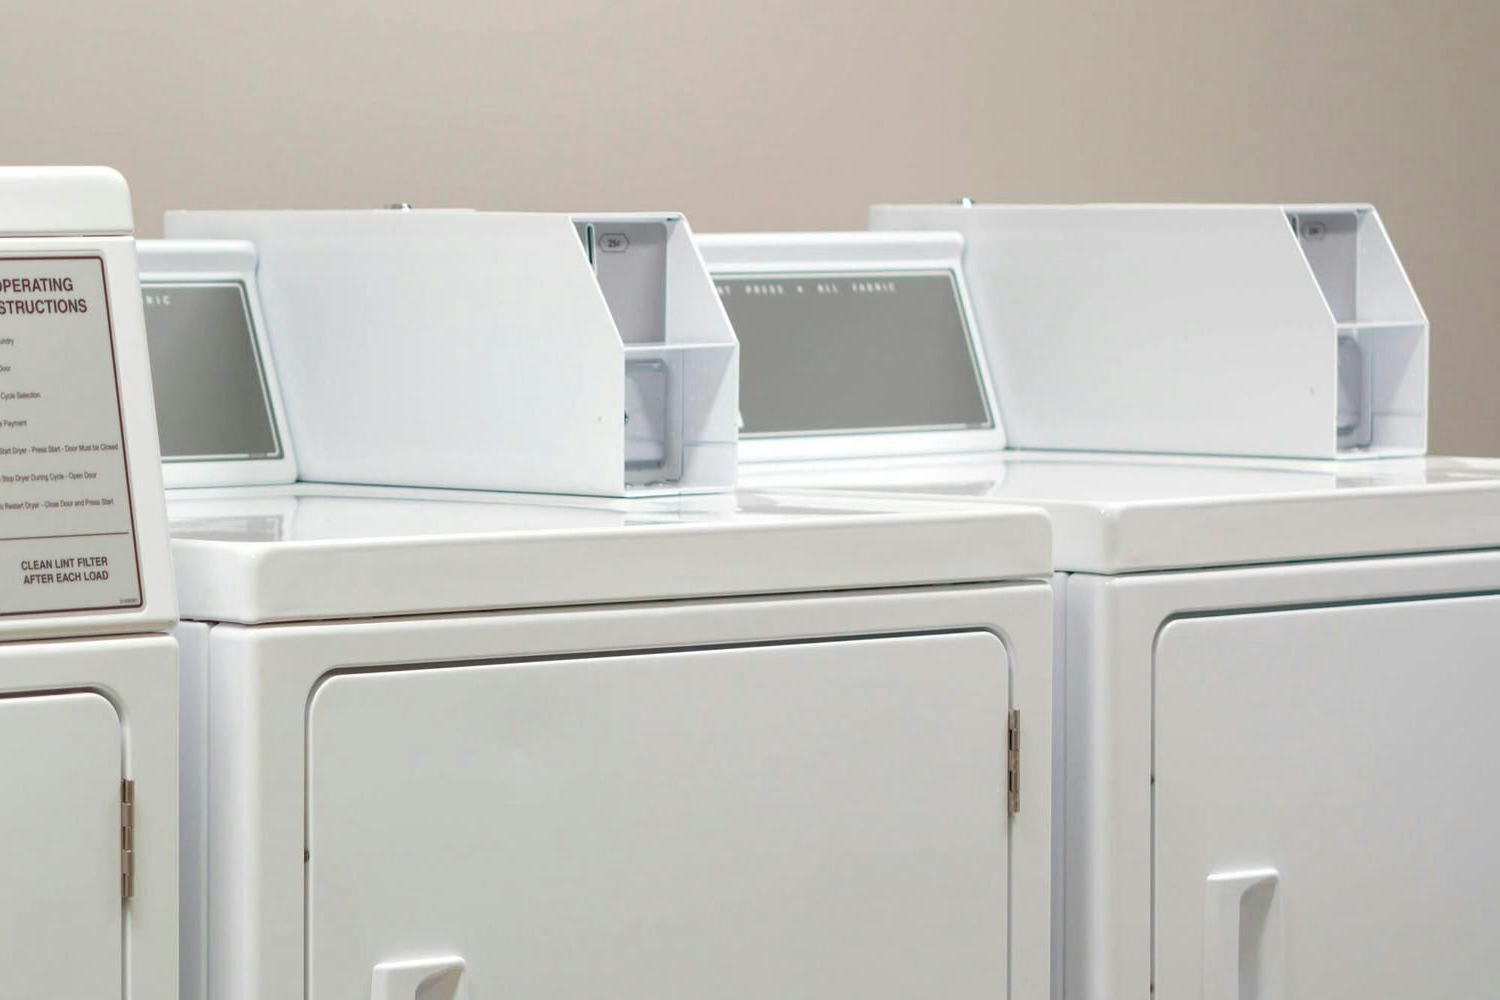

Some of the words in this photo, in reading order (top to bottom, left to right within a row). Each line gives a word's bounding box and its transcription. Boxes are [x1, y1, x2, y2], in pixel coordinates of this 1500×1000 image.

[1, 392, 16, 401] Cycle
[4, 420, 27, 428] Payment
[13, 447, 27, 455] Dryer
[2, 475, 14, 483] Stop
[15, 474, 30, 482] Dryer
[31, 473, 49, 482] During
[50, 473, 64, 482] Cycle
[69, 472, 83, 480] Open
[5, 502, 24, 510] Restart
[25, 502, 39, 510] Dryer
[21, 560, 53, 571] CLEAN
[55, 558, 74, 569] LINT
[77, 556, 108, 567] FILTER
[23, 574, 54, 585] AFTER
[57, 572, 82, 583] EACH
[84, 571, 109, 581] LOAD
